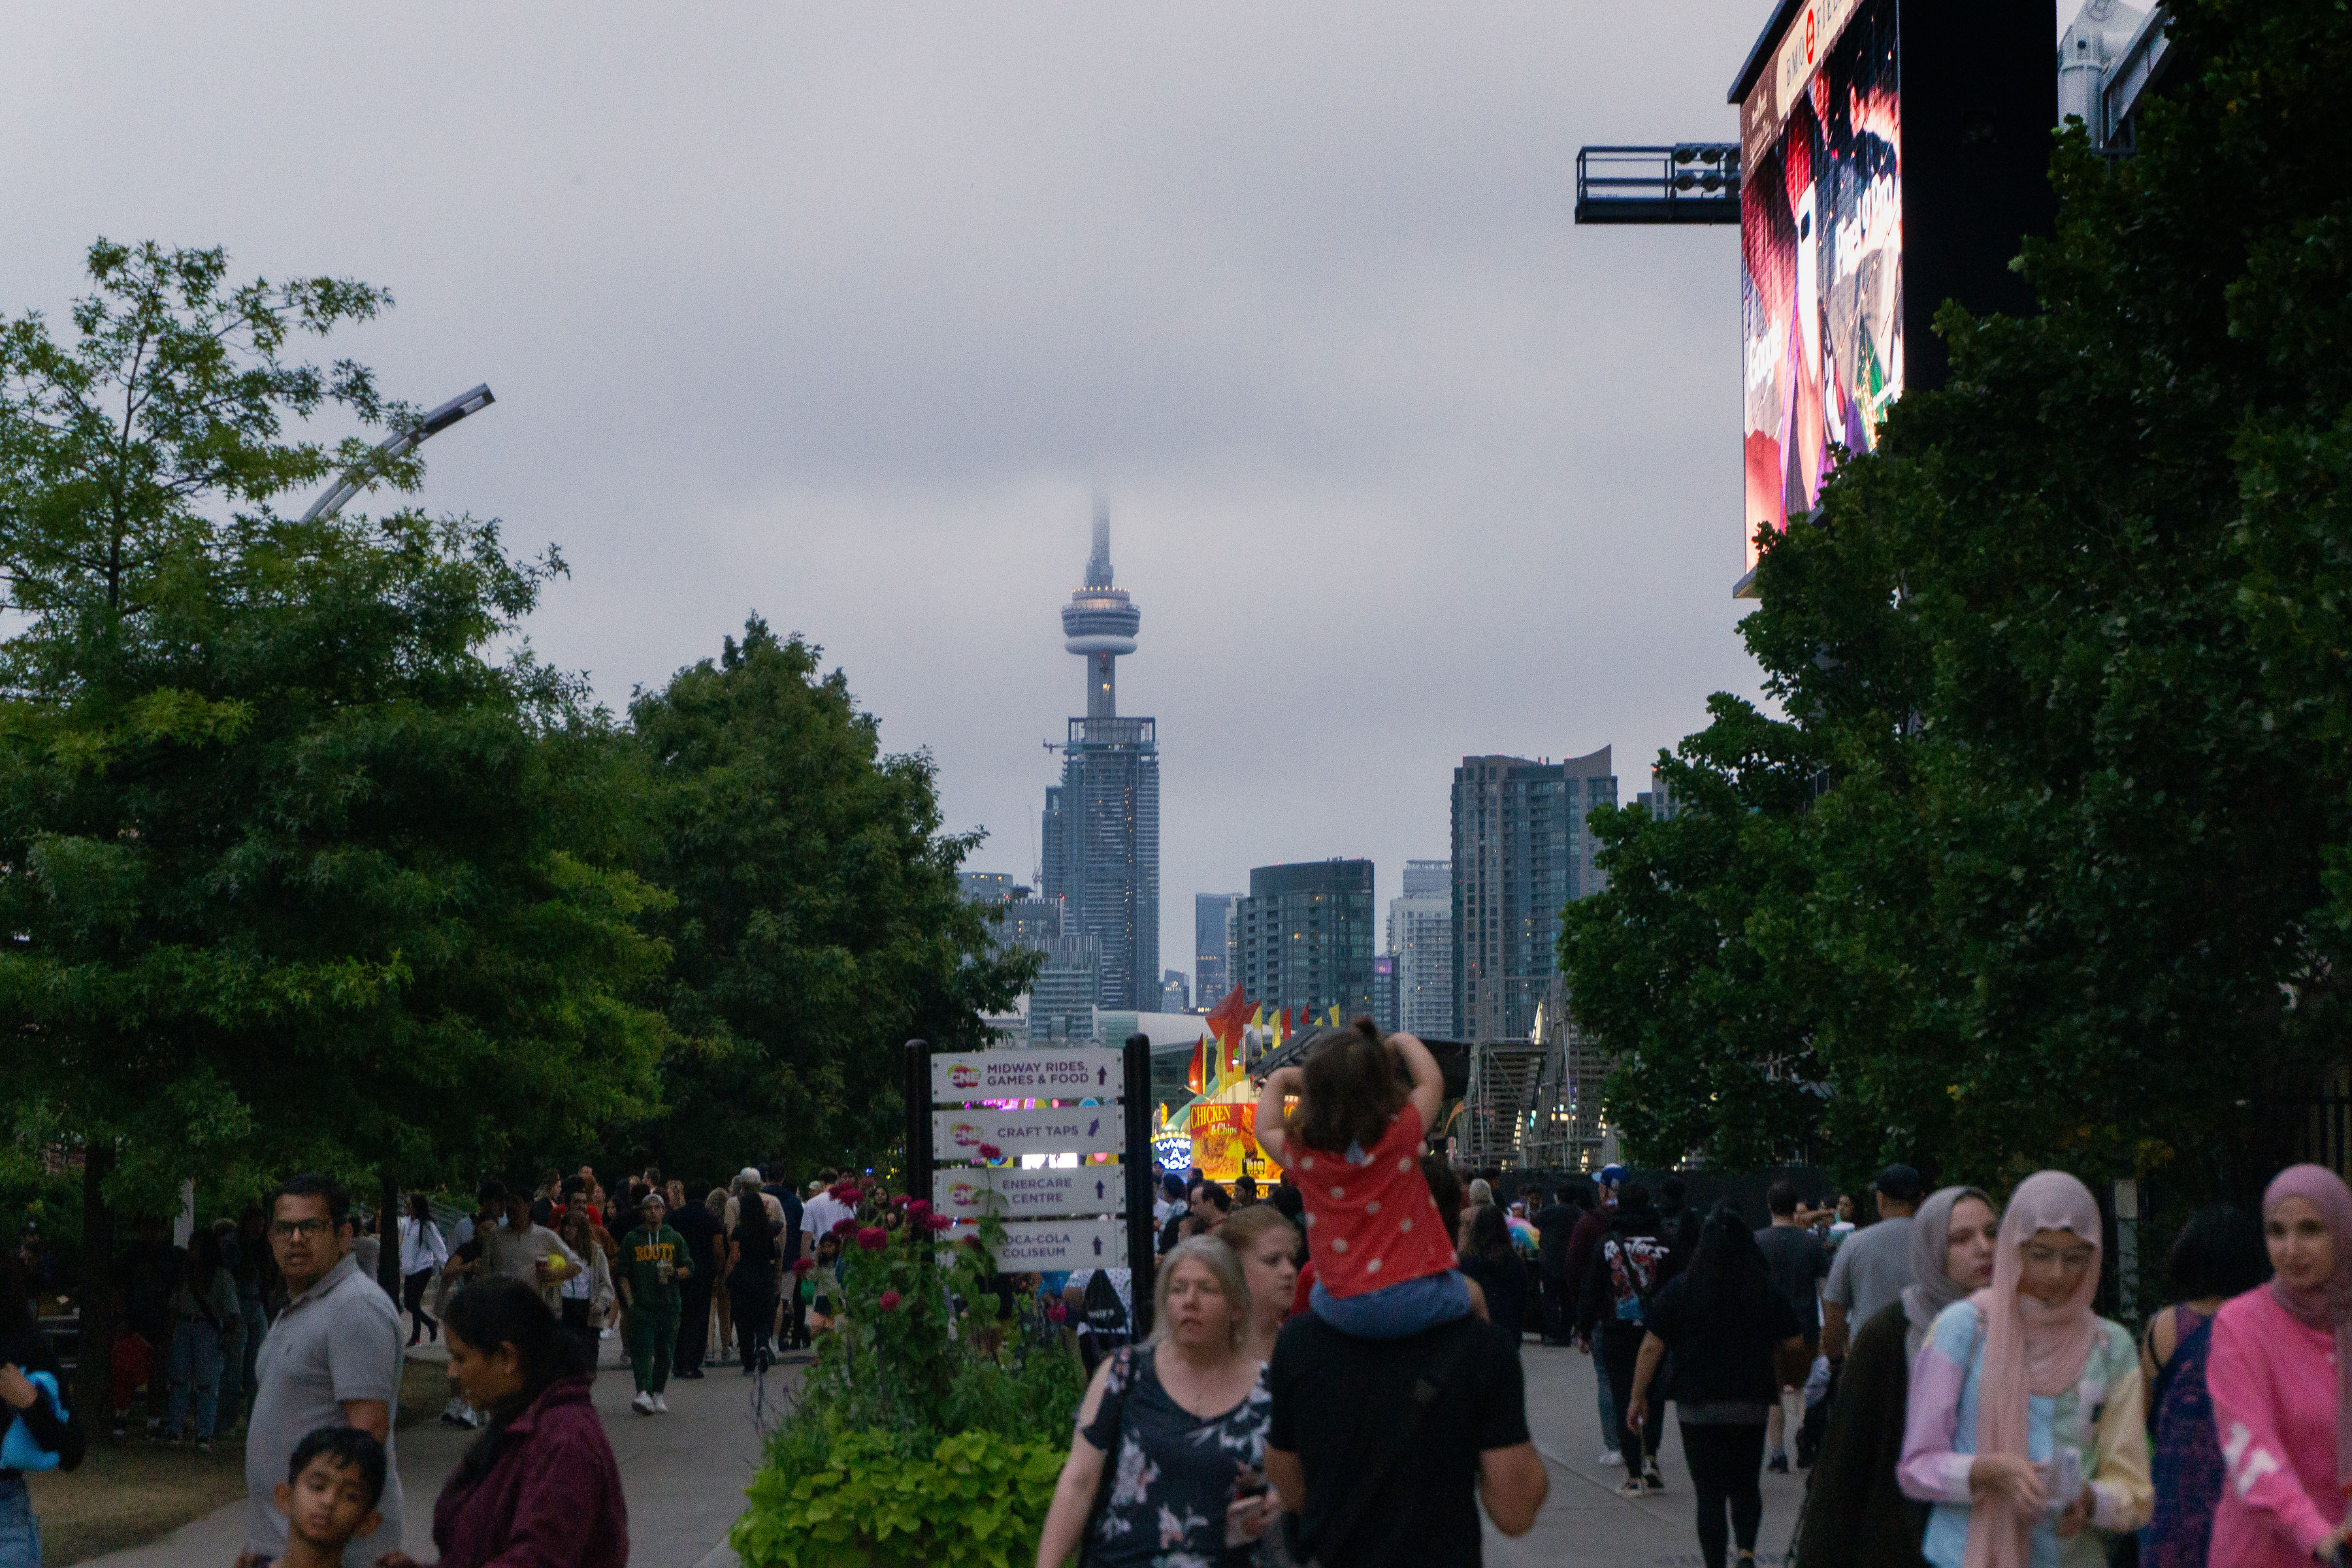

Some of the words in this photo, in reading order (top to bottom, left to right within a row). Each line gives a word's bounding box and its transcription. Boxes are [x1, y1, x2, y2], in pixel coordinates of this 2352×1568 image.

[1786, 35, 1805, 89] BMO
[1748, 310, 1782, 391] Google
[987, 1063, 1041, 1075] MIDWAY
[1045, 1062, 1088, 1072] RIDES,
[987, 1075, 1034, 1086] GAMES
[1037, 1074, 1046, 1084] &
[1051, 1072, 1089, 1084] FOOD
[1190, 1105, 1231, 1129] CHICKEN
[998, 1126, 1043, 1139] CRAFT
[1045, 1125, 1079, 1136] TAPS
[1217, 1122, 1237, 1136] Chips
[1170, 1148, 1181, 1160] A
[1002, 1177, 1072, 1189] ENERCARE
[1013, 1192, 1064, 1203] CENTRE
[1003, 1247, 1066, 1258] COLISEUM
